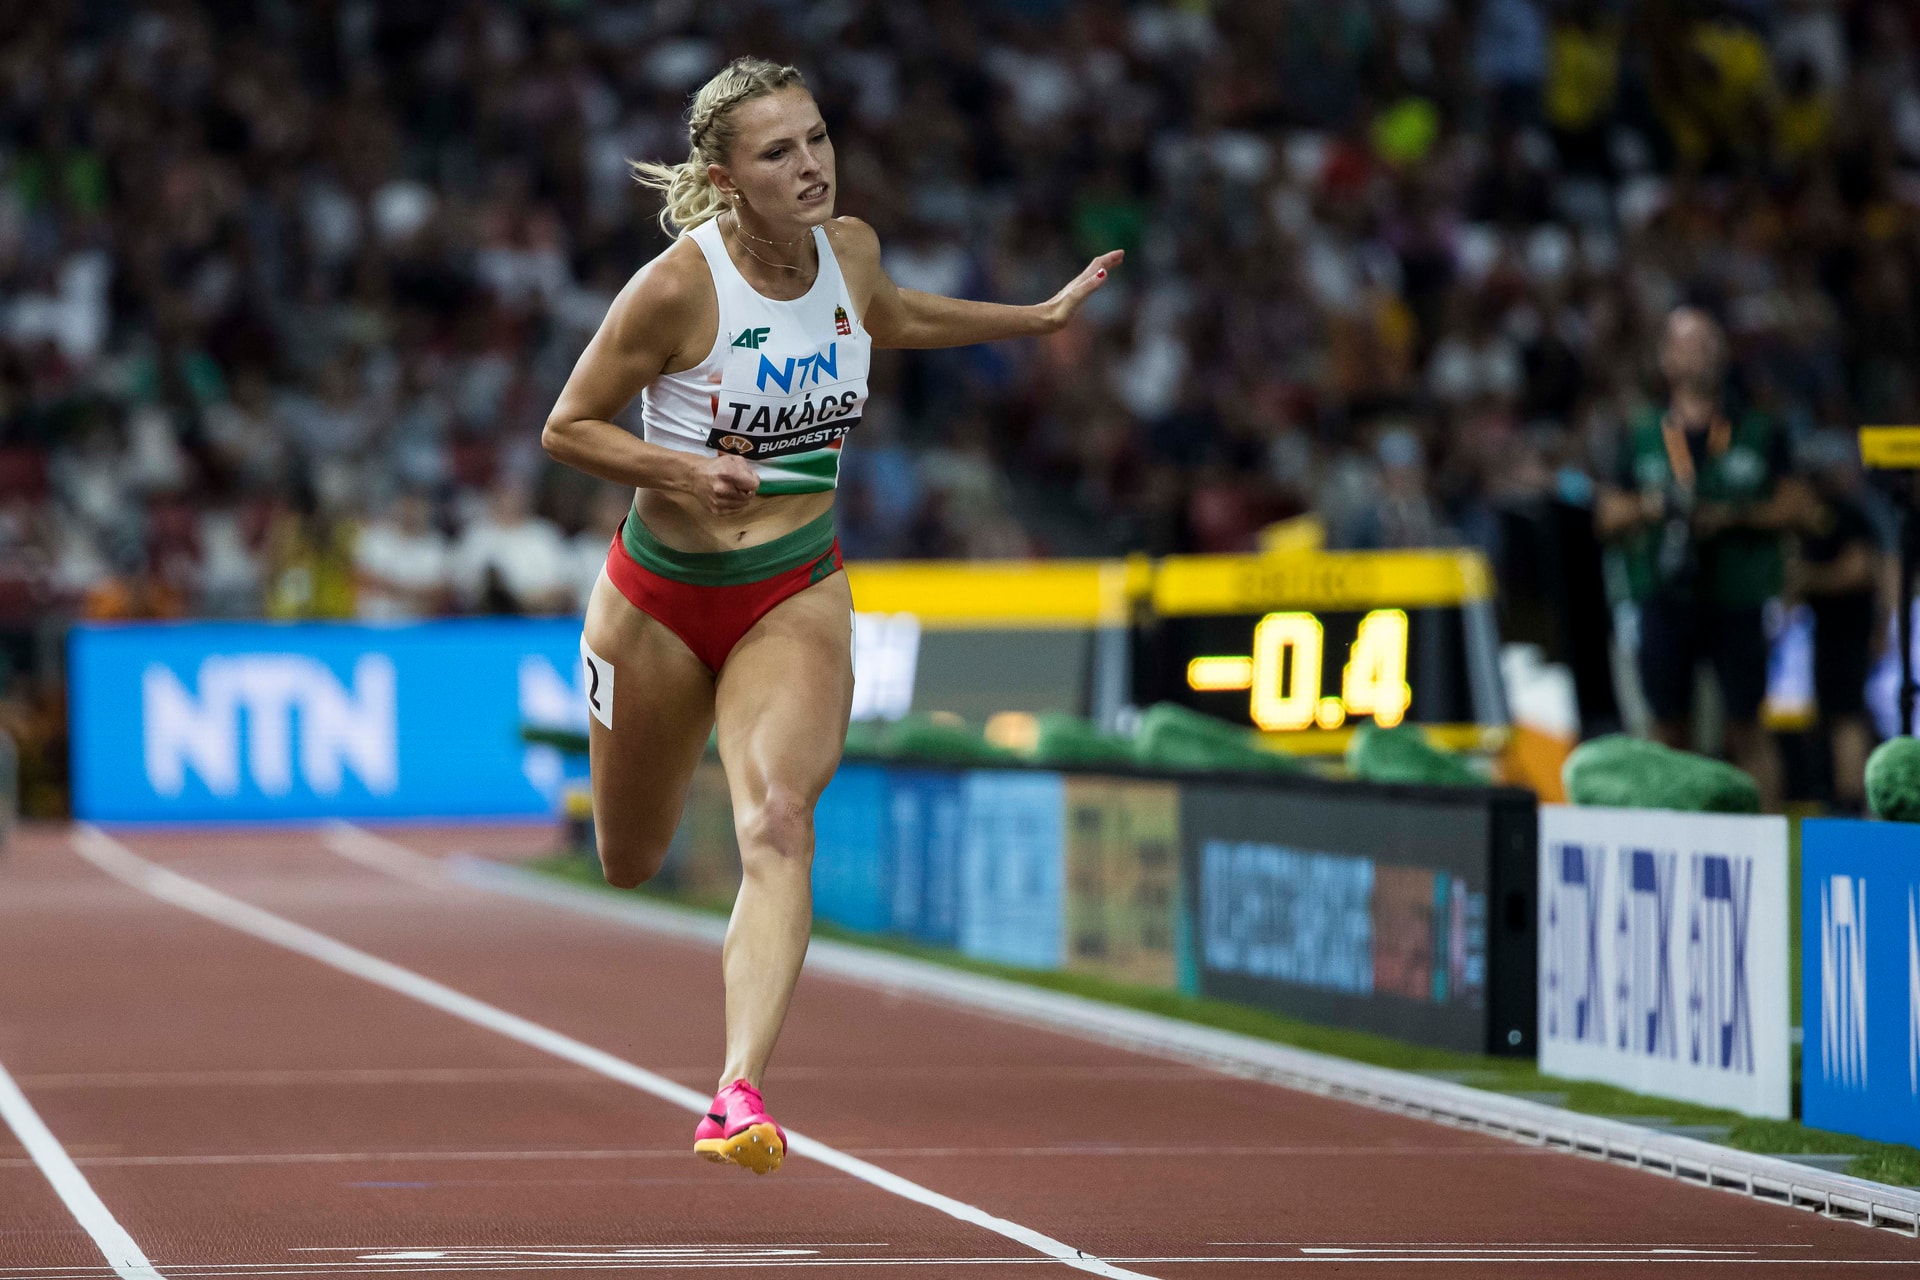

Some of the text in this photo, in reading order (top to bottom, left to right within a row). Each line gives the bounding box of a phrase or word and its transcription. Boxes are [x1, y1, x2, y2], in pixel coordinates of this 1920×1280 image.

[756, 342, 838, 394] NTN
[728, 391, 858, 433] TAKÁCS
[758, 428, 833, 453] BUDAPEST
[586, 655, 601, 712] 2
[1187, 609, 1411, 731] -0.4
[141, 651, 399, 800] NTN
[1820, 874, 1868, 1093] NTN
